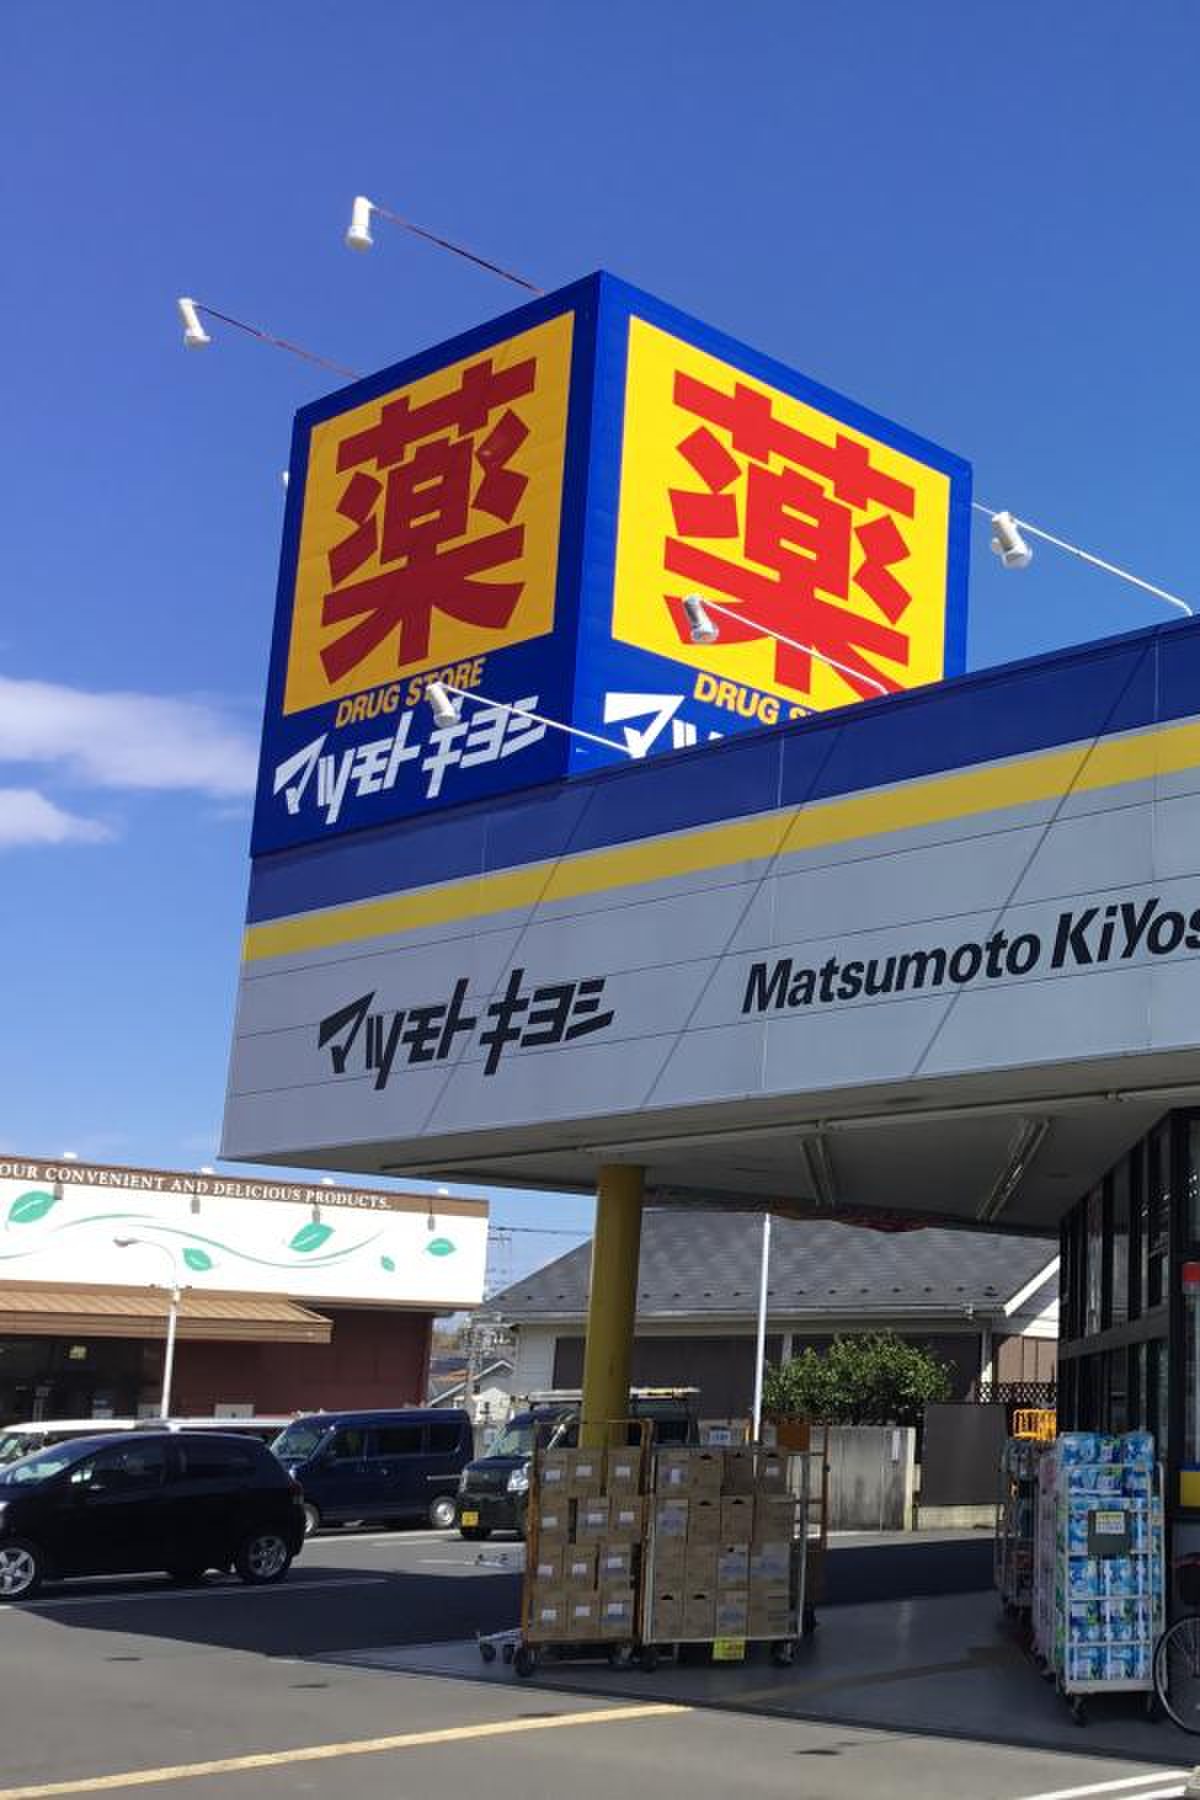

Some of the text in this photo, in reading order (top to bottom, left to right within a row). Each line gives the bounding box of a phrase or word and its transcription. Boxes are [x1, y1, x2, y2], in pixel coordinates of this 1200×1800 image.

[319, 357, 537, 685] 薬
[662, 369, 916, 702] 薬
[335, 657, 487, 729] DRUG STORE
[693, 672, 780, 725] DRUG
[273, 696, 546, 825] マツモトキヨシ
[741, 928, 1040, 1013] Matsumoto
[318, 968, 615, 1090] マツモトキヨシ
[45, 1167, 166, 1190] CONVENIENT
[171, 1178, 208, 1195] AND
[213, 1183, 300, 1201] DELICIOUS
[305, 1189, 392, 1209] PRODUCTS.
